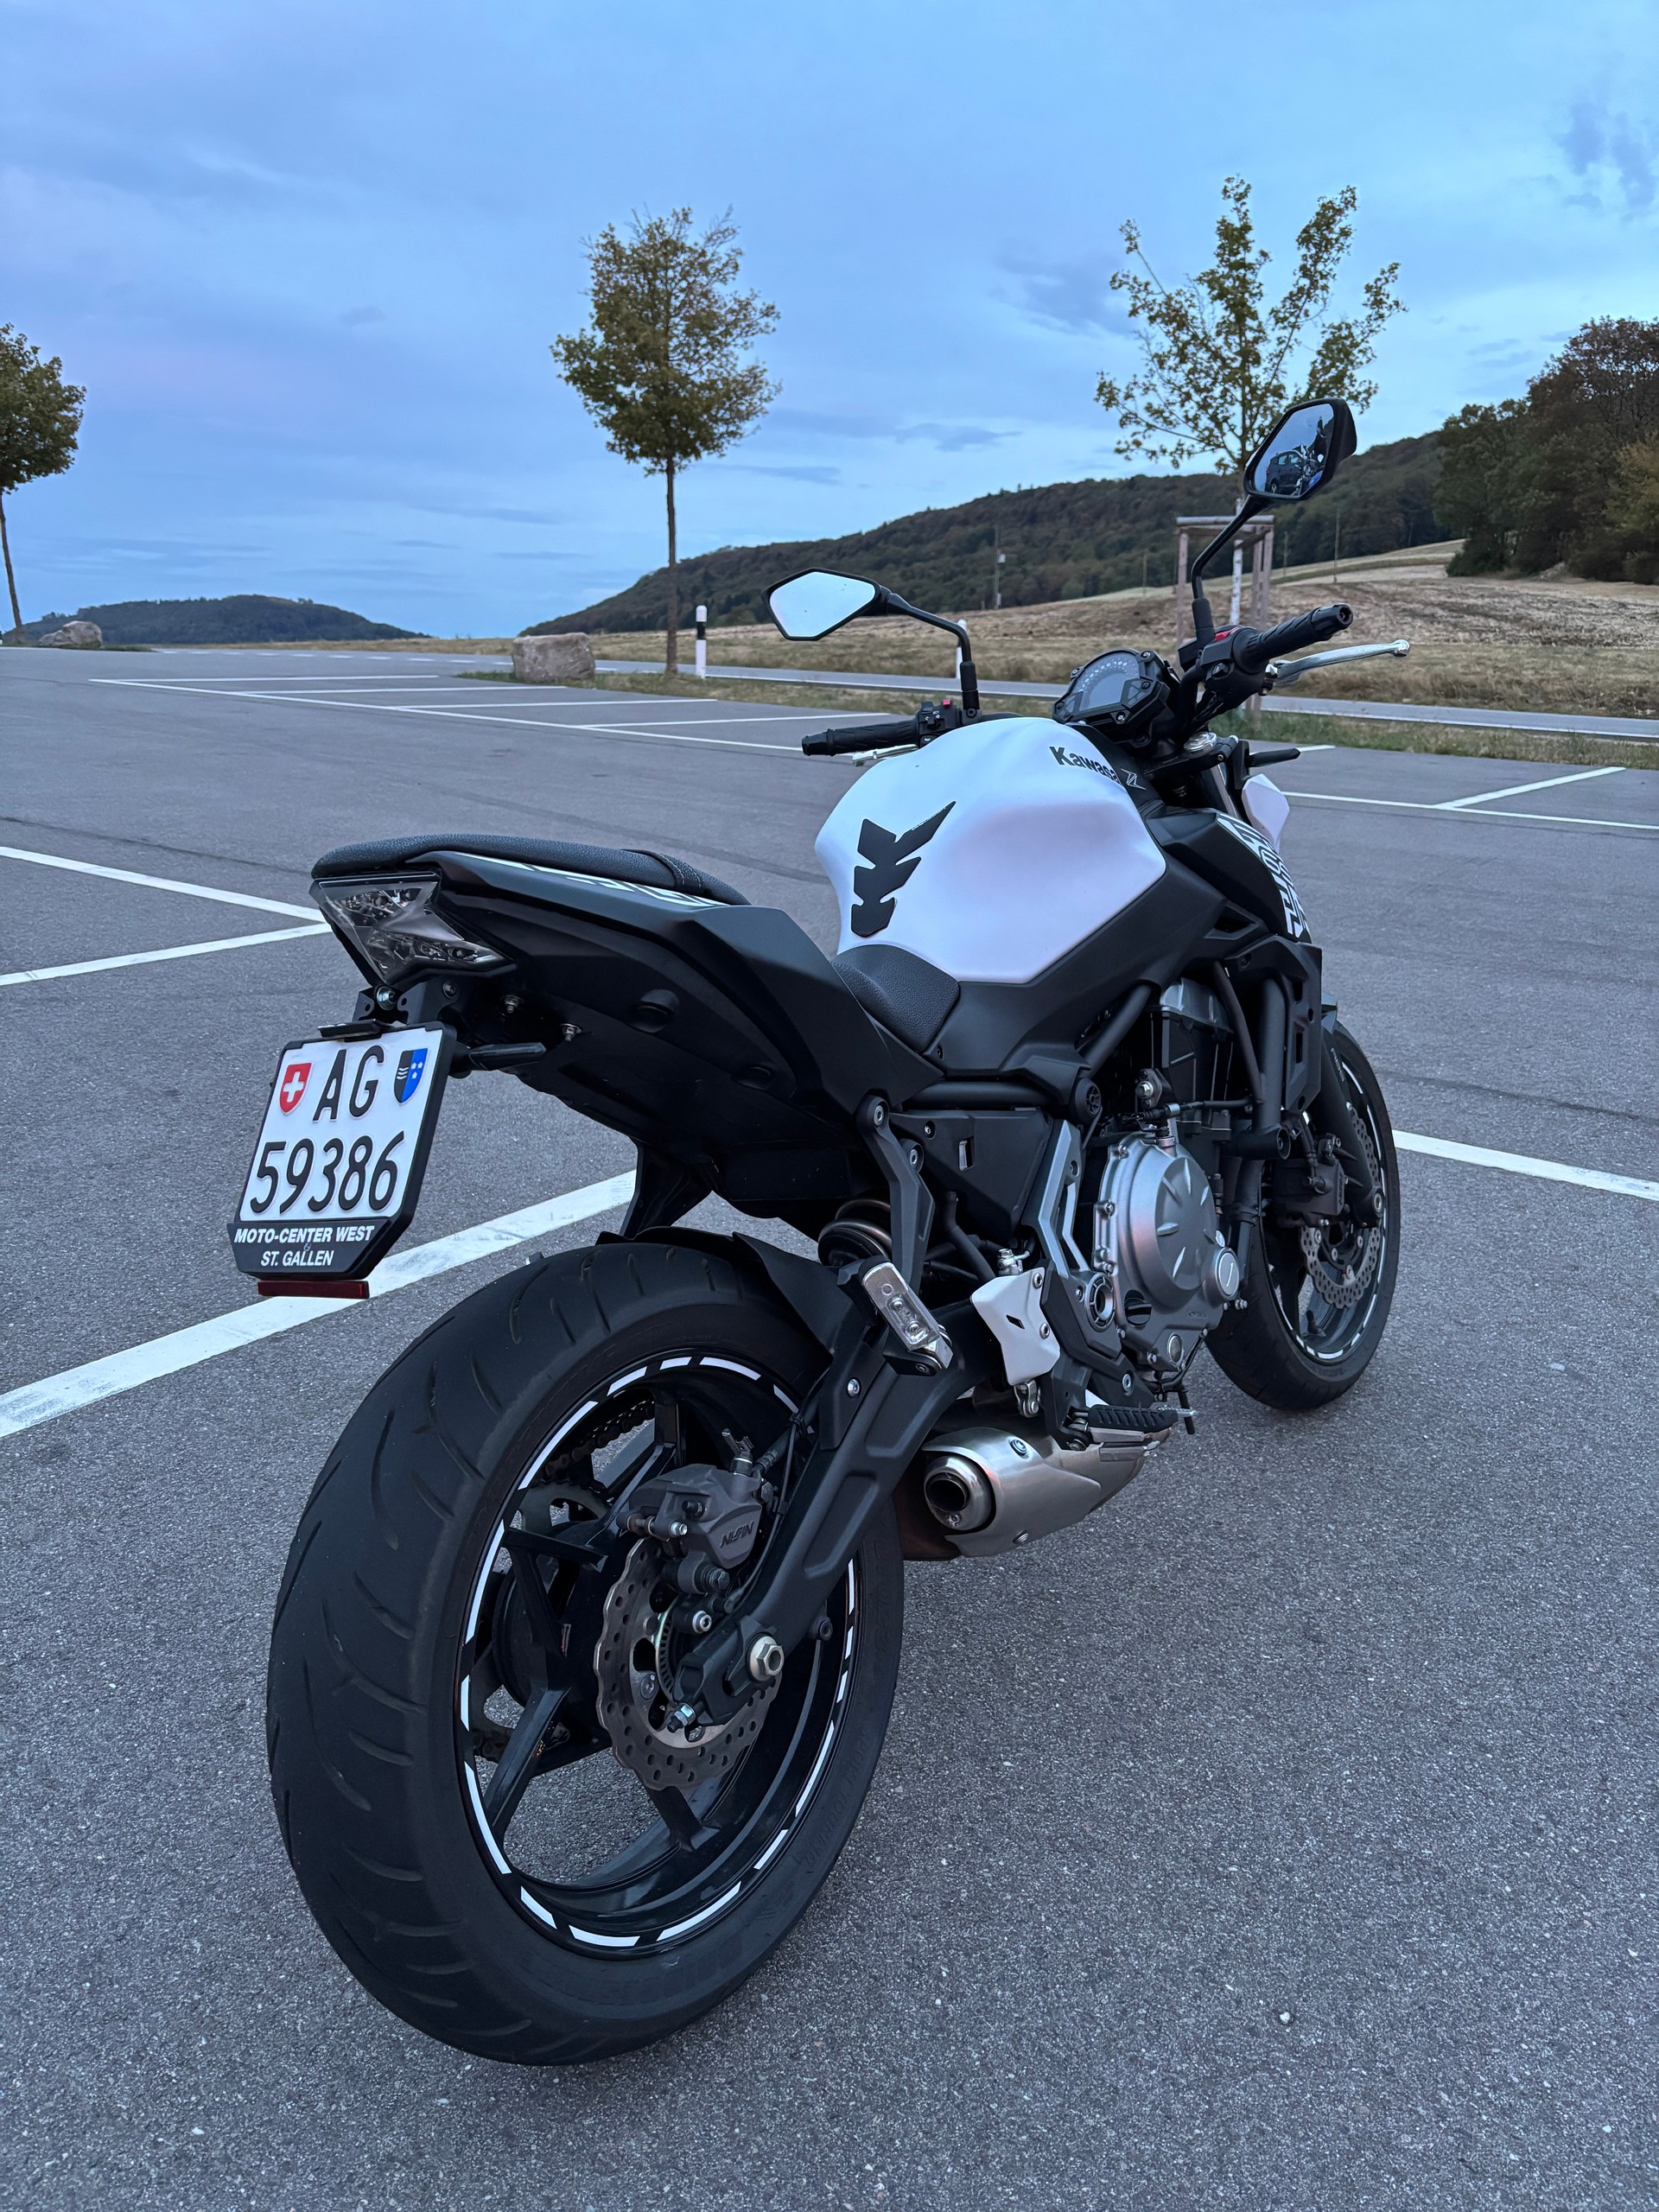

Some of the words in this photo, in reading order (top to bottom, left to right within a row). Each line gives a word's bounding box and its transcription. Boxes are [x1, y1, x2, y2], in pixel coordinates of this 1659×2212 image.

[313, 1045, 385, 1122] AG
[250, 1131, 404, 1214] 59386
[234, 1228, 332, 1243] MOTO-CENTER
[335, 1225, 375, 1242] WEST
[260, 1251, 278, 1267] ST.
[282, 1250, 334, 1267] GALLEN
